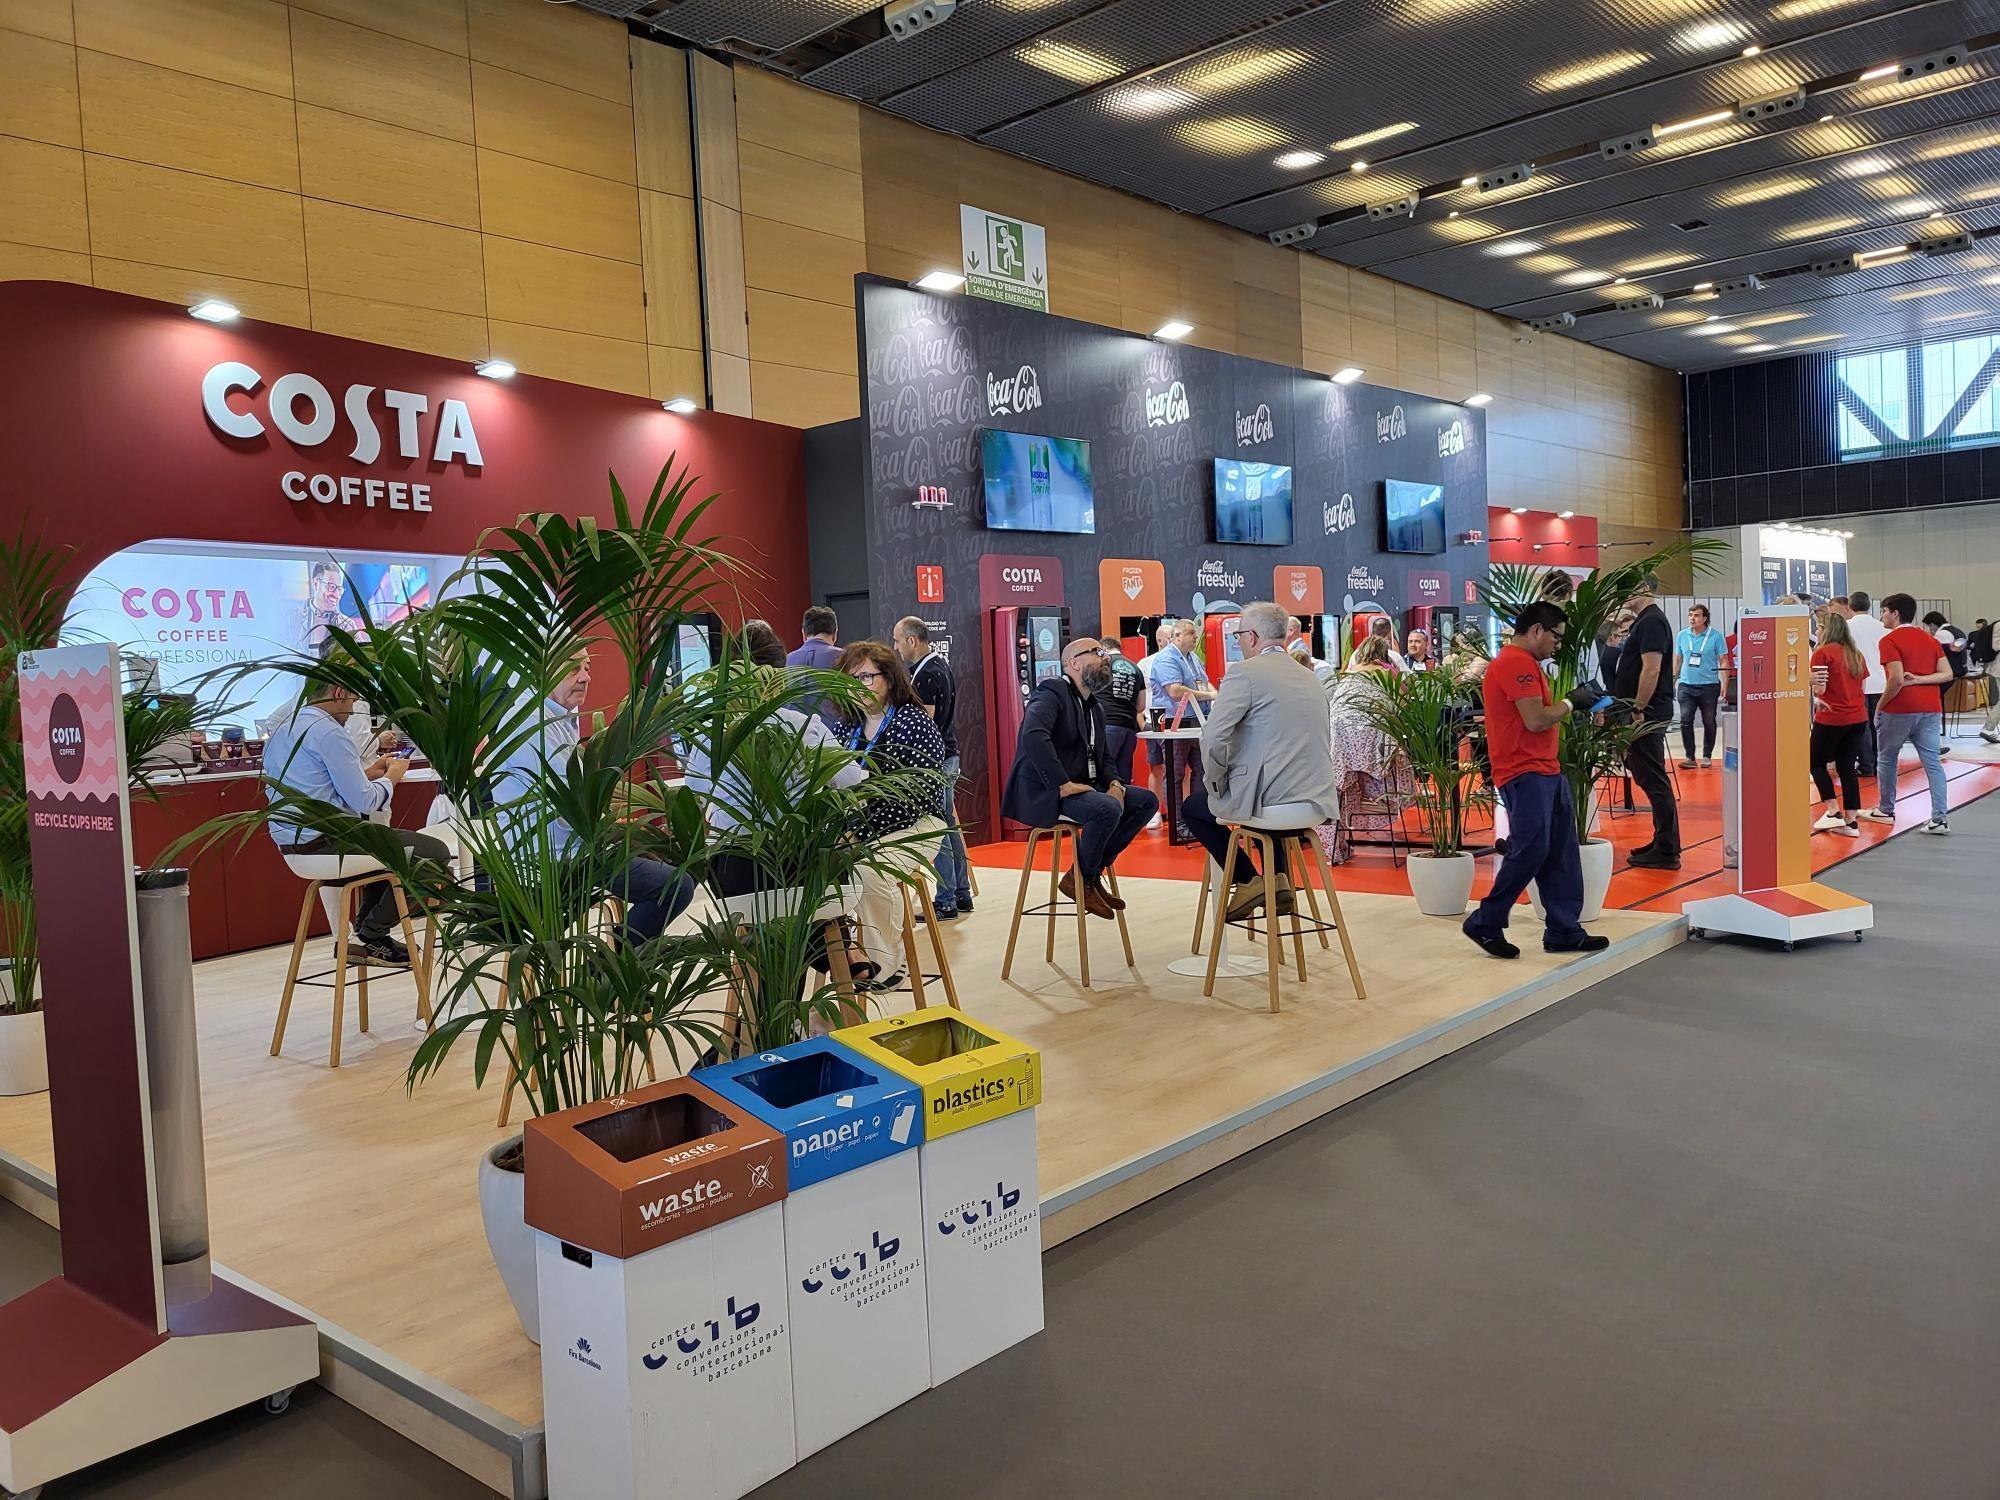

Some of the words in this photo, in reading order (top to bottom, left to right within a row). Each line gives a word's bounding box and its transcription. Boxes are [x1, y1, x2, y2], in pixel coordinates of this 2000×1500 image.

[968, 276, 997, 289] SORTIDA
[972, 286, 994, 297] SALIDA
[996, 291, 1004, 299] DE
[1005, 293, 1042, 308] EMERGENCIA
[201, 361, 484, 467] COSTA
[281, 470, 432, 513] COFFEE
[1002, 568, 1042, 584] COSTA
[1197, 568, 1244, 595] freestyle
[1346, 574, 1384, 596] freestyle
[1419, 579, 1440, 591] COSTA
[122, 588, 254, 623] COSTA
[157, 630, 228, 642] COFFEE
[1746, 692, 1772, 700] RECYCLE
[52, 728, 82, 745] COSTA
[34, 812, 68, 828] RECYCLE
[69, 814, 90, 830] CUPS
[92, 816, 114, 831] HERE
[934, 1078, 1004, 1118] plastics
[662, 1141, 718, 1164] waste
[792, 1119, 864, 1163] paper
[830, 1144, 844, 1154] paper
[639, 1178, 722, 1222] waste
[944, 1200, 976, 1218] centre
[640, 1210, 681, 1230] escombraries
[961, 1208, 1018, 1238] convencions
[972, 1210, 1037, 1245] internacional
[984, 1226, 1028, 1250] barcelona
[808, 1252, 847, 1275] centre
[830, 1259, 897, 1296] convencions
[844, 1258, 920, 1302] internacional
[856, 1277, 910, 1308] barcelona
[651, 1322, 696, 1350] centre
[676, 1326, 756, 1371] convencions
[692, 1324, 784, 1376] internacional
[708, 1345, 772, 1382] barcelona
